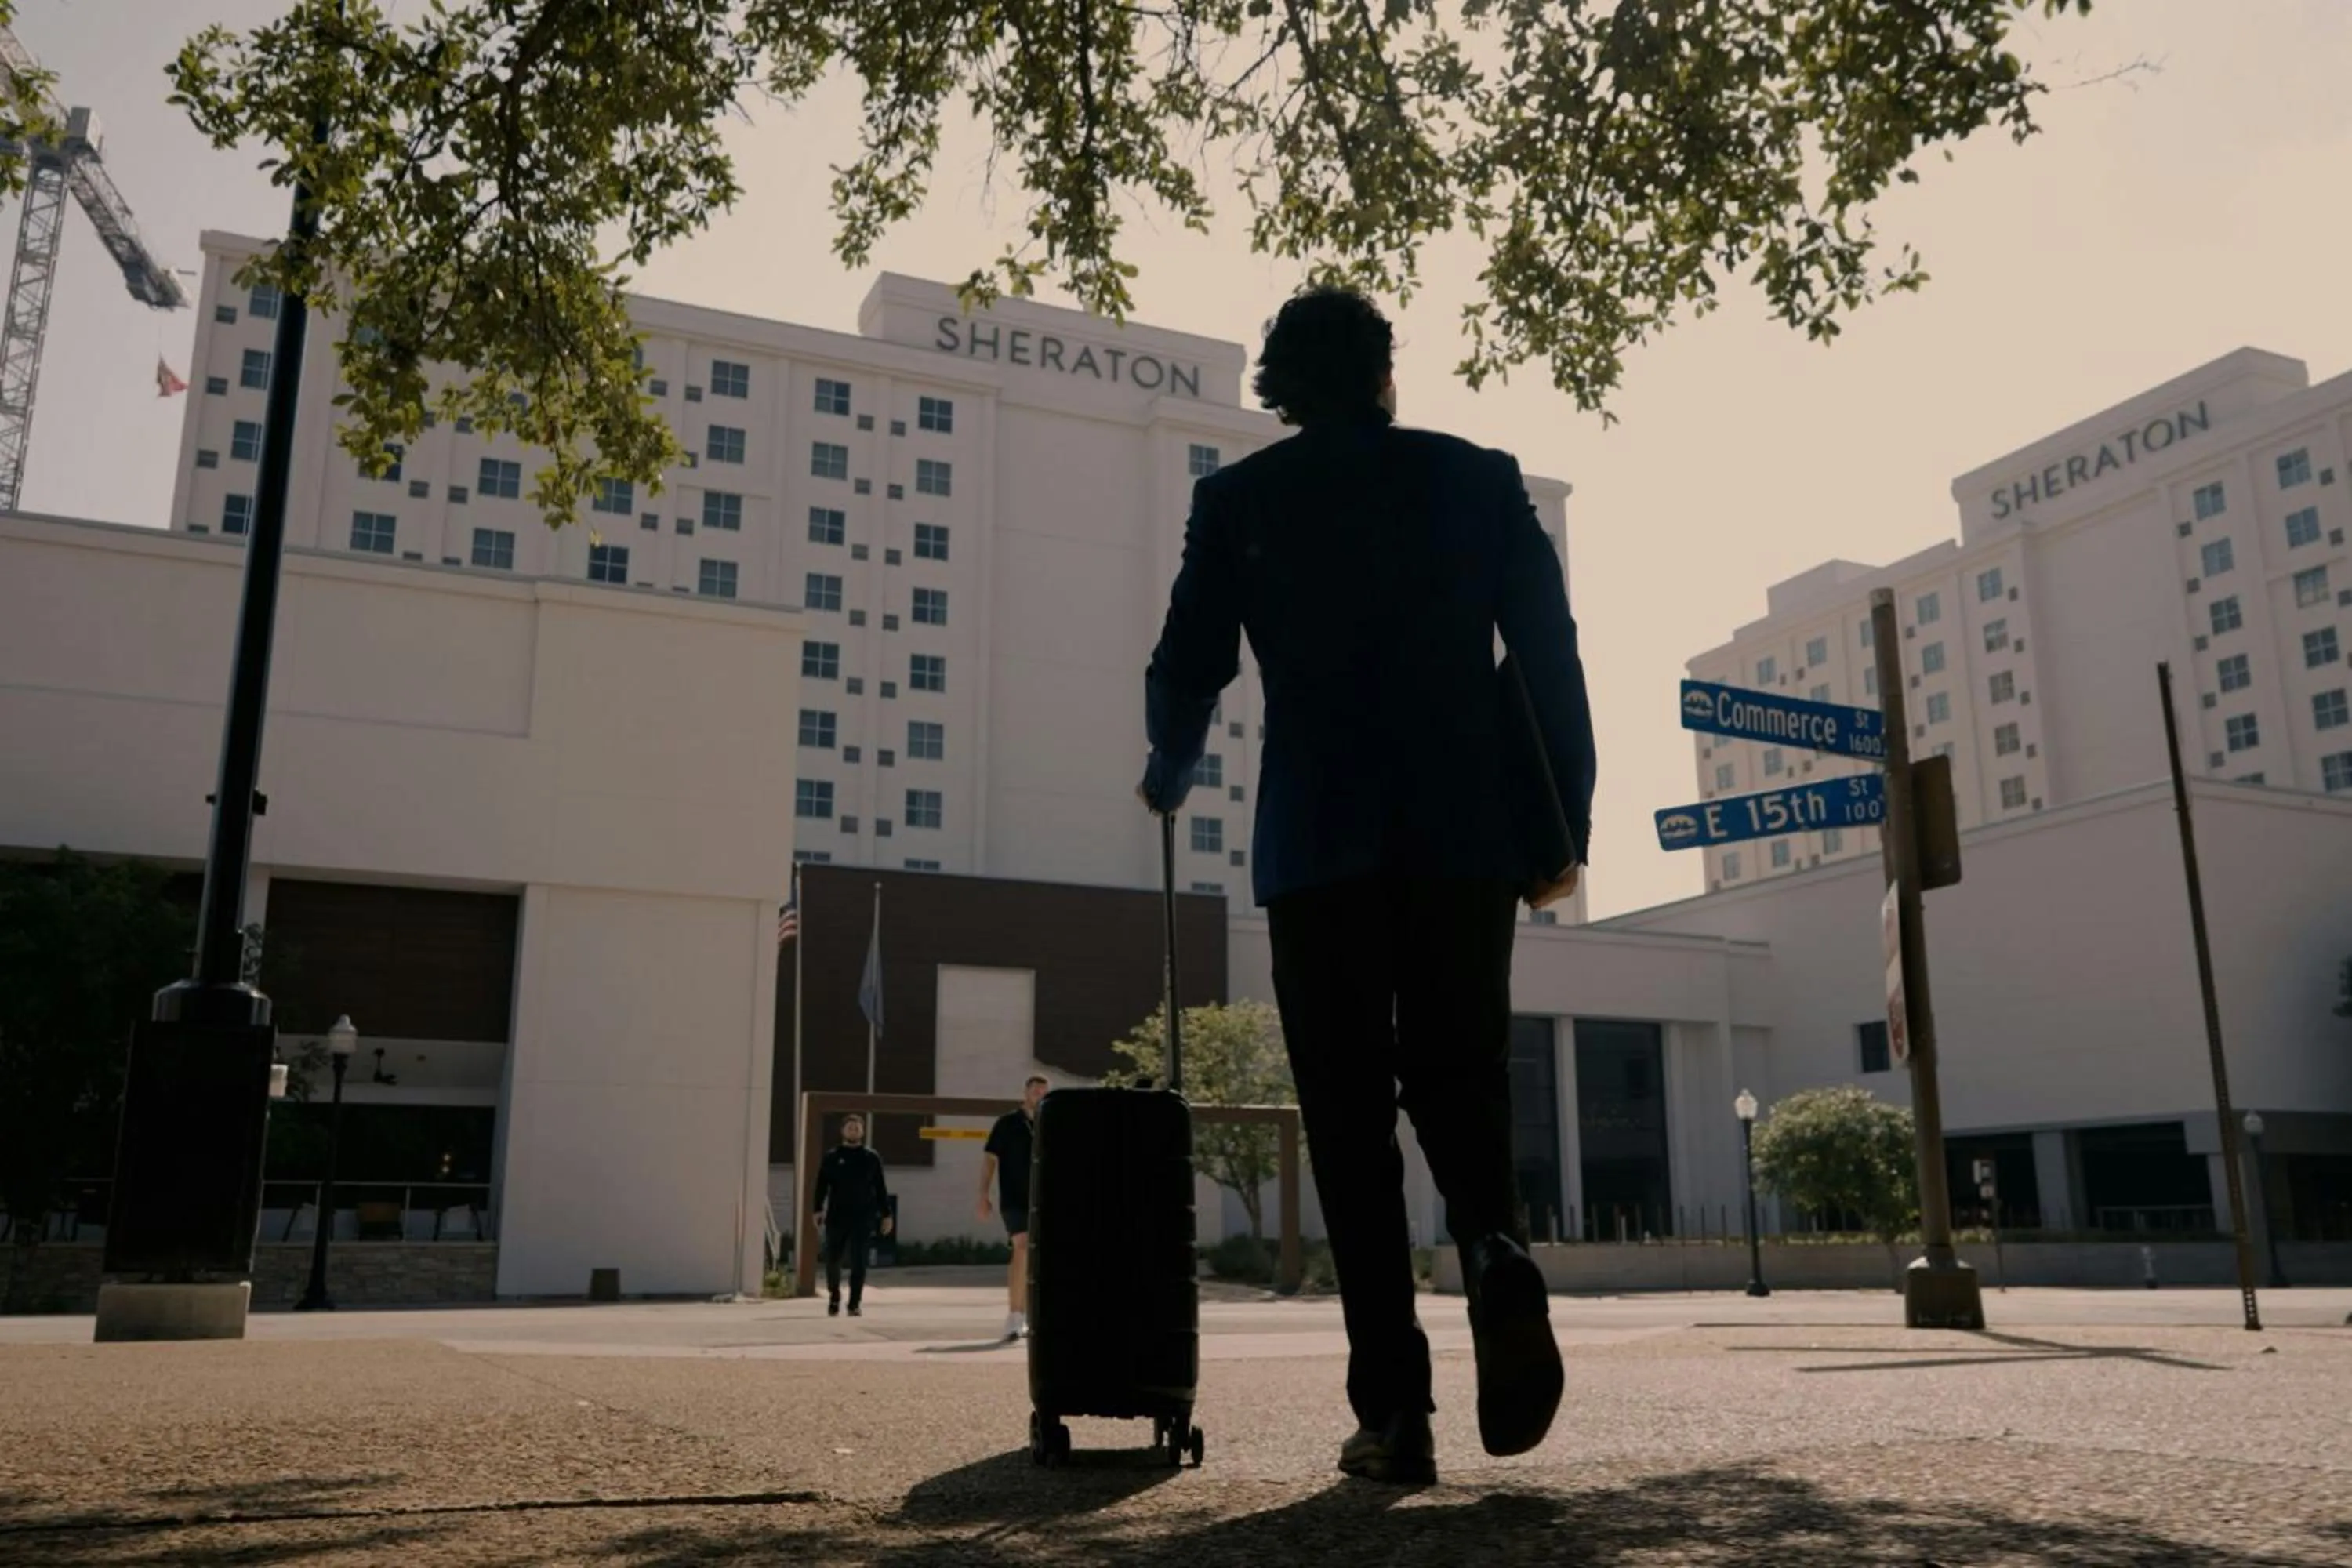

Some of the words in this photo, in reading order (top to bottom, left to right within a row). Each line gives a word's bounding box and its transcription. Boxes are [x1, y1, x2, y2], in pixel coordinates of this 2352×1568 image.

[935, 316, 1200, 397] SHERATON
[1990, 400, 2209, 519] SHERATON
[1715, 691, 1838, 745] Commerce
[1854, 710, 1870, 729] St
[1848, 732, 1882, 755] 1600
[1704, 804, 1729, 839] E
[1745, 789, 1828, 833] 15th
[1848, 777, 1869, 797] St
[1844, 800, 1881, 822] 100
